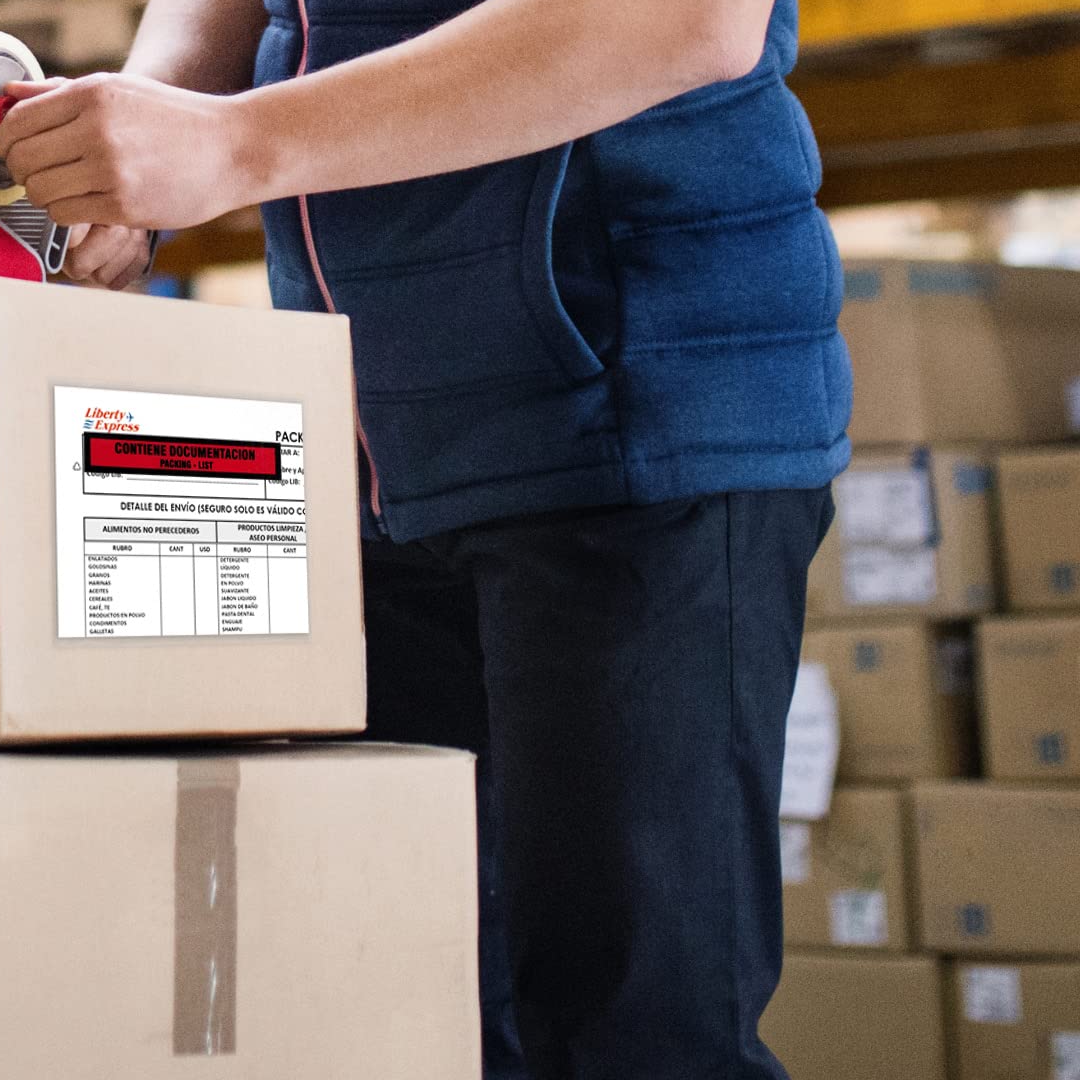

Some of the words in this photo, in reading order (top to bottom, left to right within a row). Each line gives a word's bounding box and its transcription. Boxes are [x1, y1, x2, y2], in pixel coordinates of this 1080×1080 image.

[85, 407, 126, 422] Liberty
[95, 420, 140, 433] Express
[114, 442, 167, 456] CONTIENE
[170, 445, 255, 460] DOCUMENTACION
[160, 459, 192, 469] PACKING
[198, 461, 213, 470] LIST
[120, 502, 152, 511] DETALLE
[154, 503, 168, 512] DEL
[171, 502, 195, 512] ENVÍO
[198, 504, 232, 514] (SEGURO
[234, 505, 255, 514] SOLO
[256, 506, 265, 514] ES
[267, 504, 295, 515] VÁLIDO
[238, 524, 275, 532] PRODUCTOS
